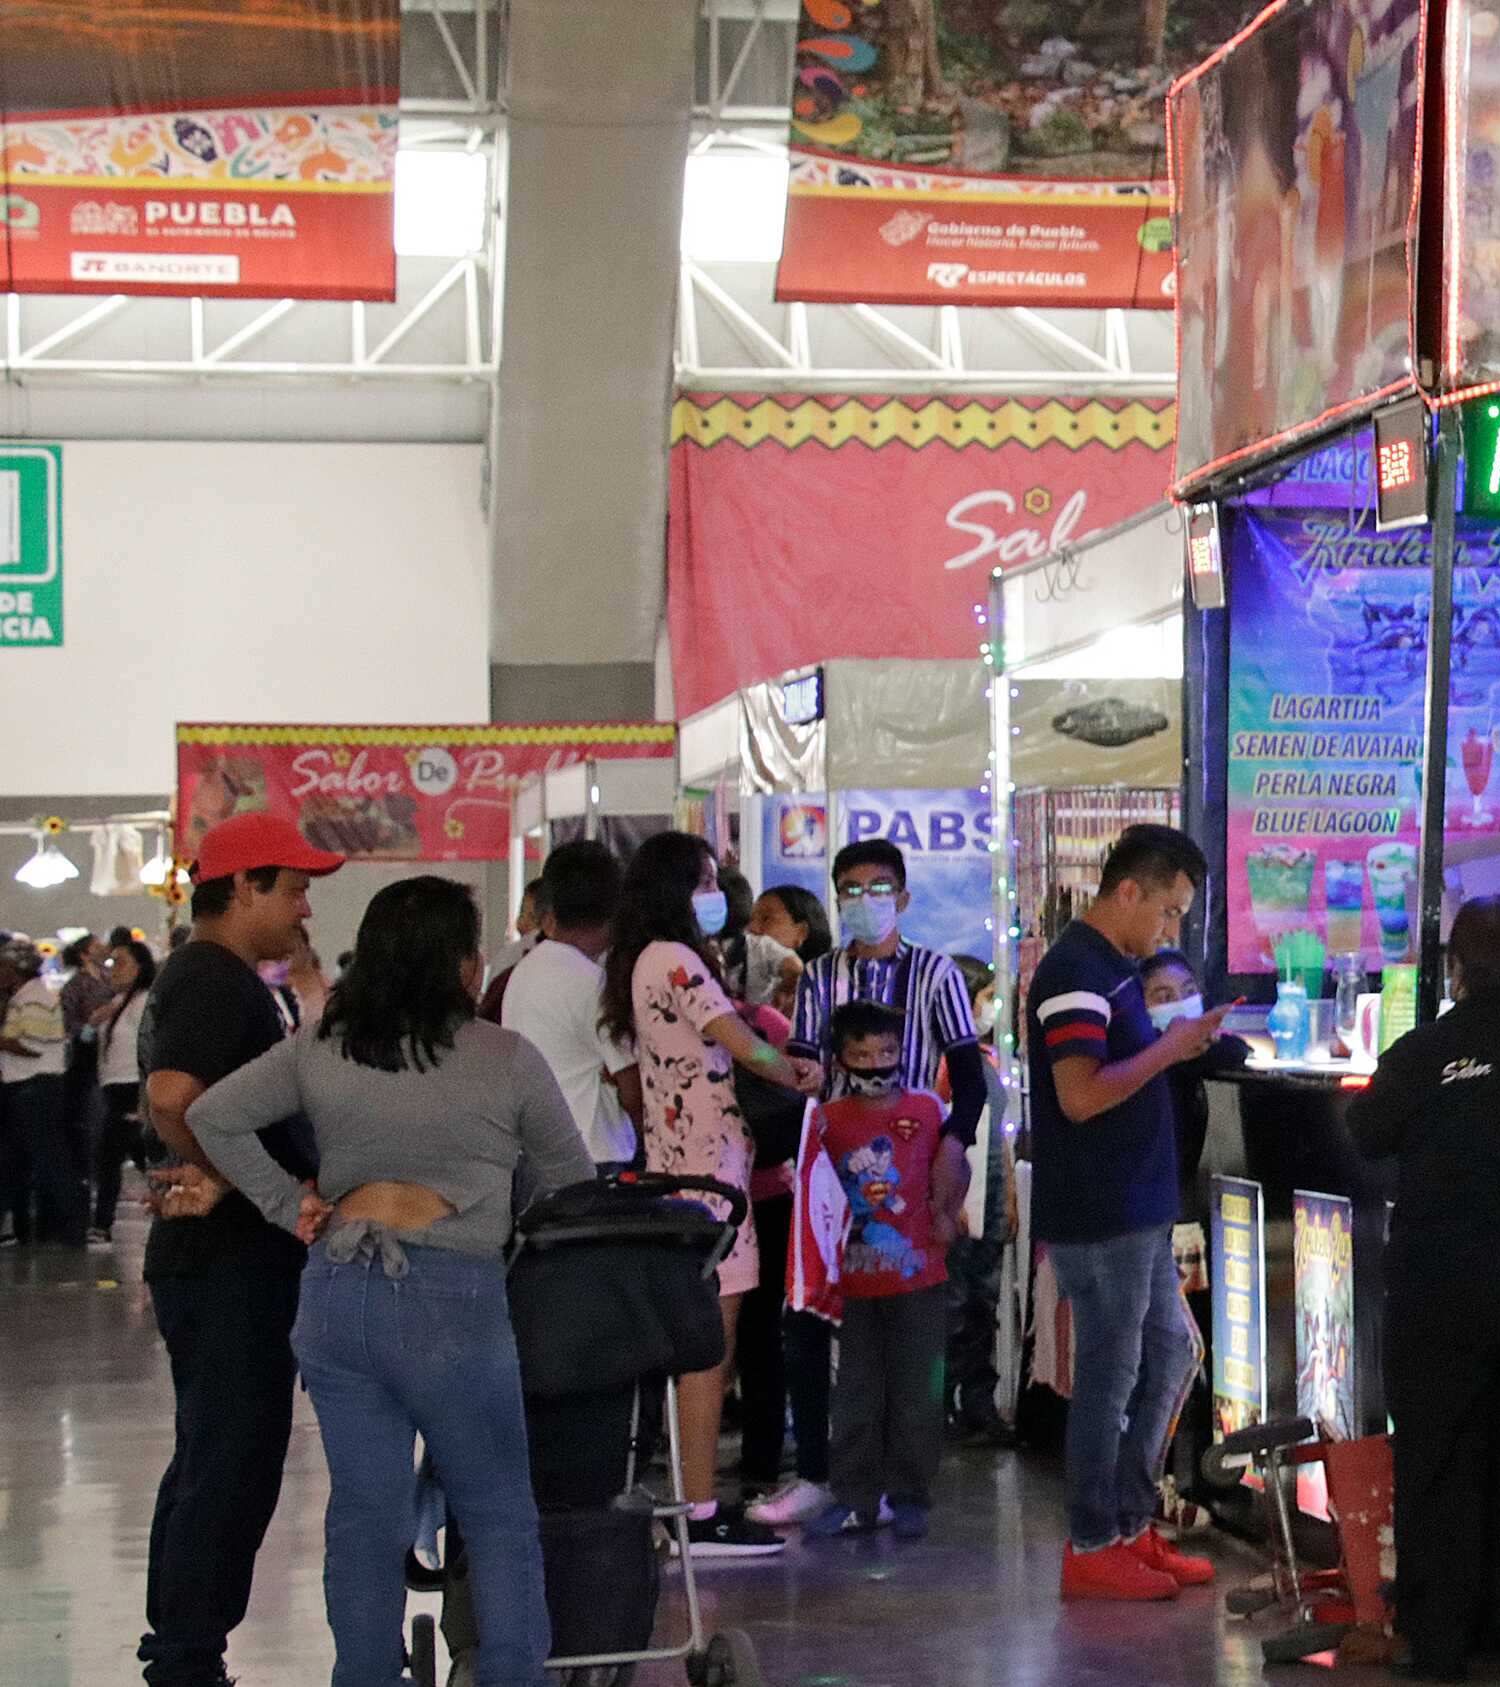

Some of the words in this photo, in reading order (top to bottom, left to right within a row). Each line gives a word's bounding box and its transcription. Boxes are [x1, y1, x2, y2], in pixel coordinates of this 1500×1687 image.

[144, 201, 297, 227] PUEBLA
[1029, 224, 1087, 239] Puebla
[1272, 696, 1381, 721] LAGARTIJA
[1233, 733, 1306, 759] SEMEN
[1311, 734, 1340, 759] DE
[1342, 735, 1419, 759] AVATAR
[291, 749, 403, 797] Sabor
[417, 760, 449, 781] De
[1255, 772, 1323, 797] PERLA
[1327, 772, 1398, 797] NEGRA
[1254, 810, 1309, 834] BLUE
[1312, 810, 1399, 834] LAGOON
